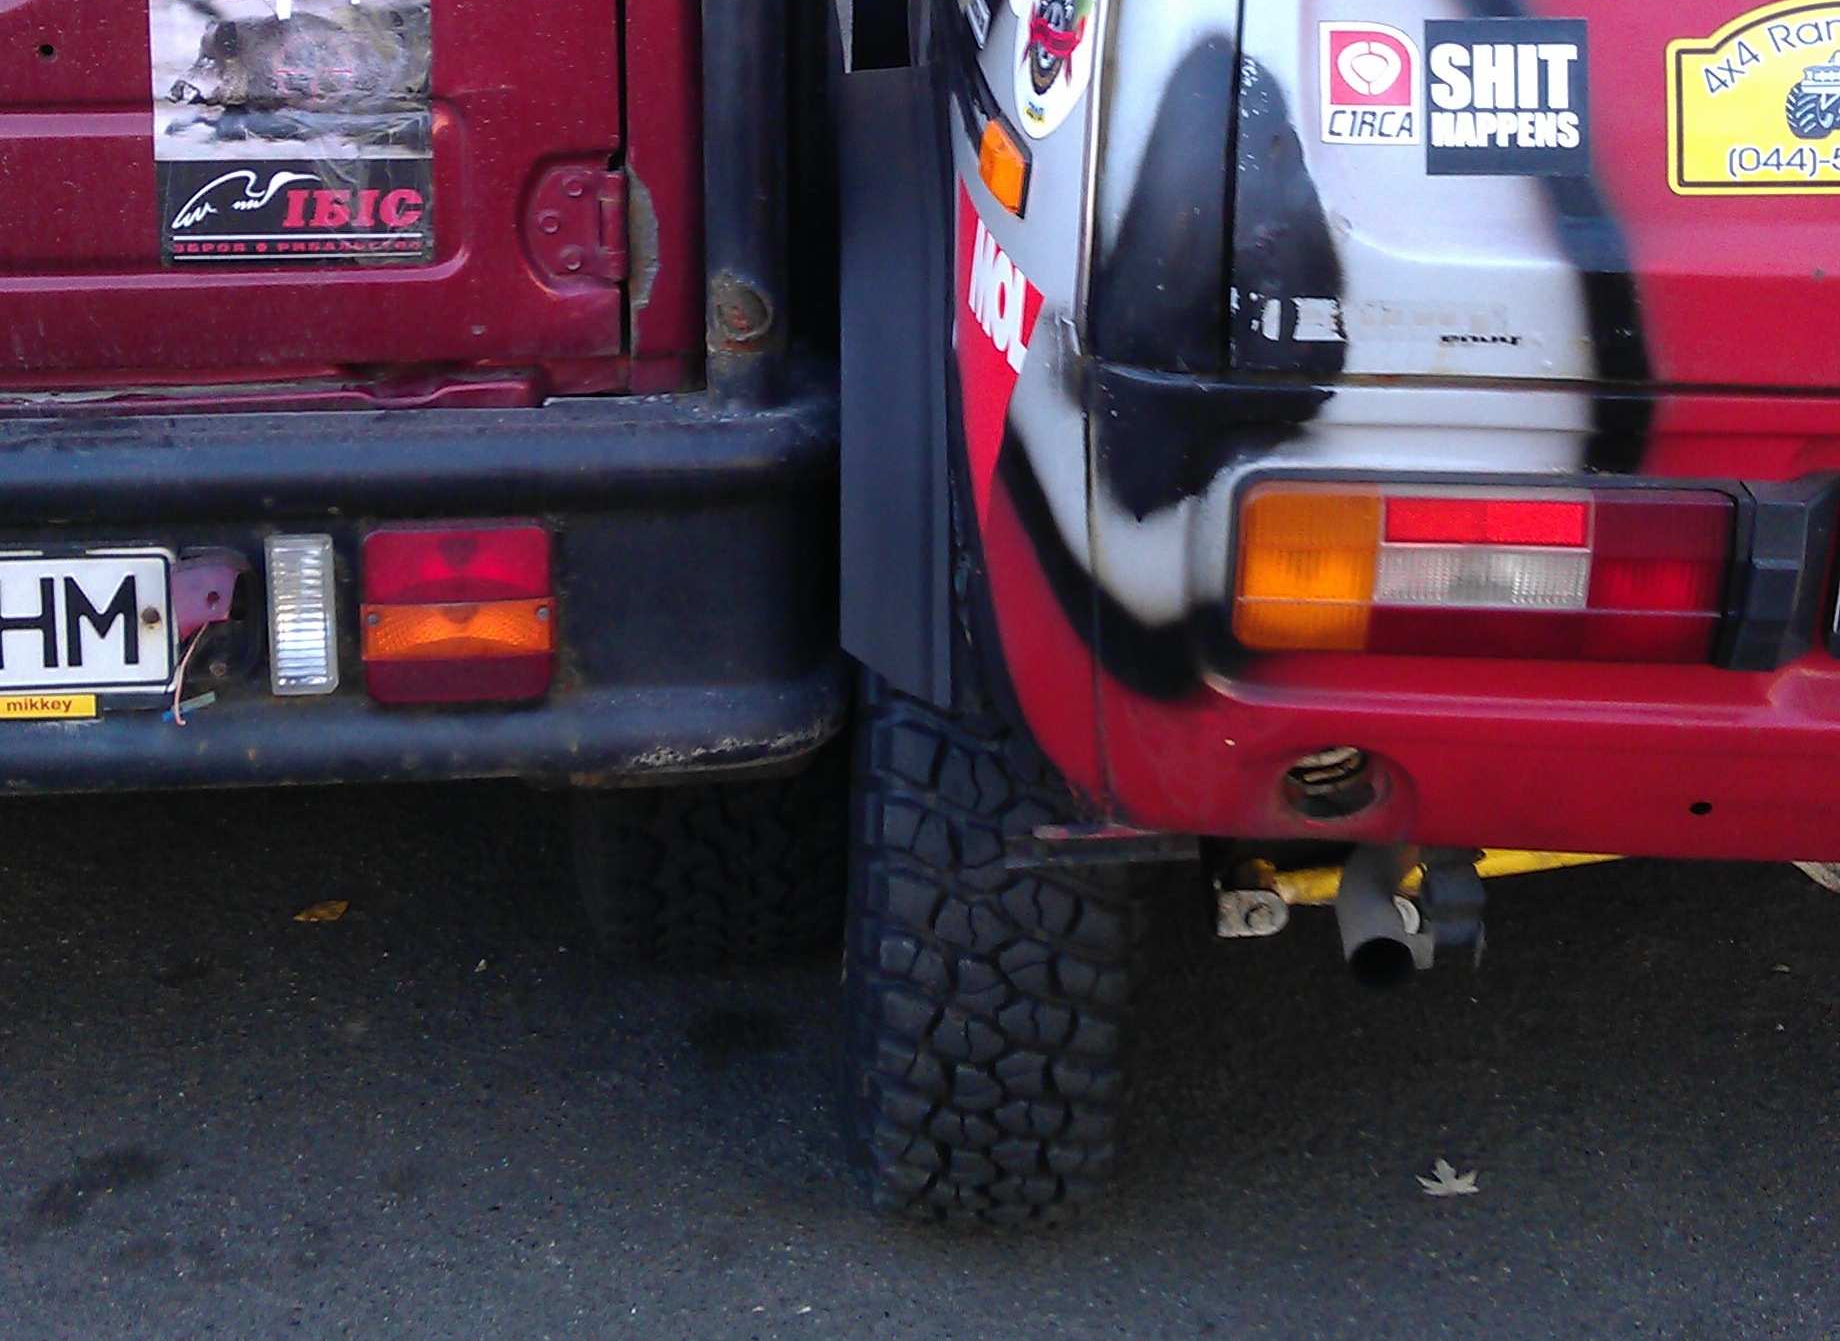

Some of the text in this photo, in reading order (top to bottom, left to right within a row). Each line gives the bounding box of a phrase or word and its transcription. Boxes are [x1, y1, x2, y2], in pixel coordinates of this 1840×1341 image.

[1430, 43, 1578, 109] SHIT
[1704, 40, 1760, 94] 4x4
[1328, 109, 1414, 138] CIRCA
[1431, 111, 1580, 148] HAPPENS
[6, 697, 74, 713] mikkey
